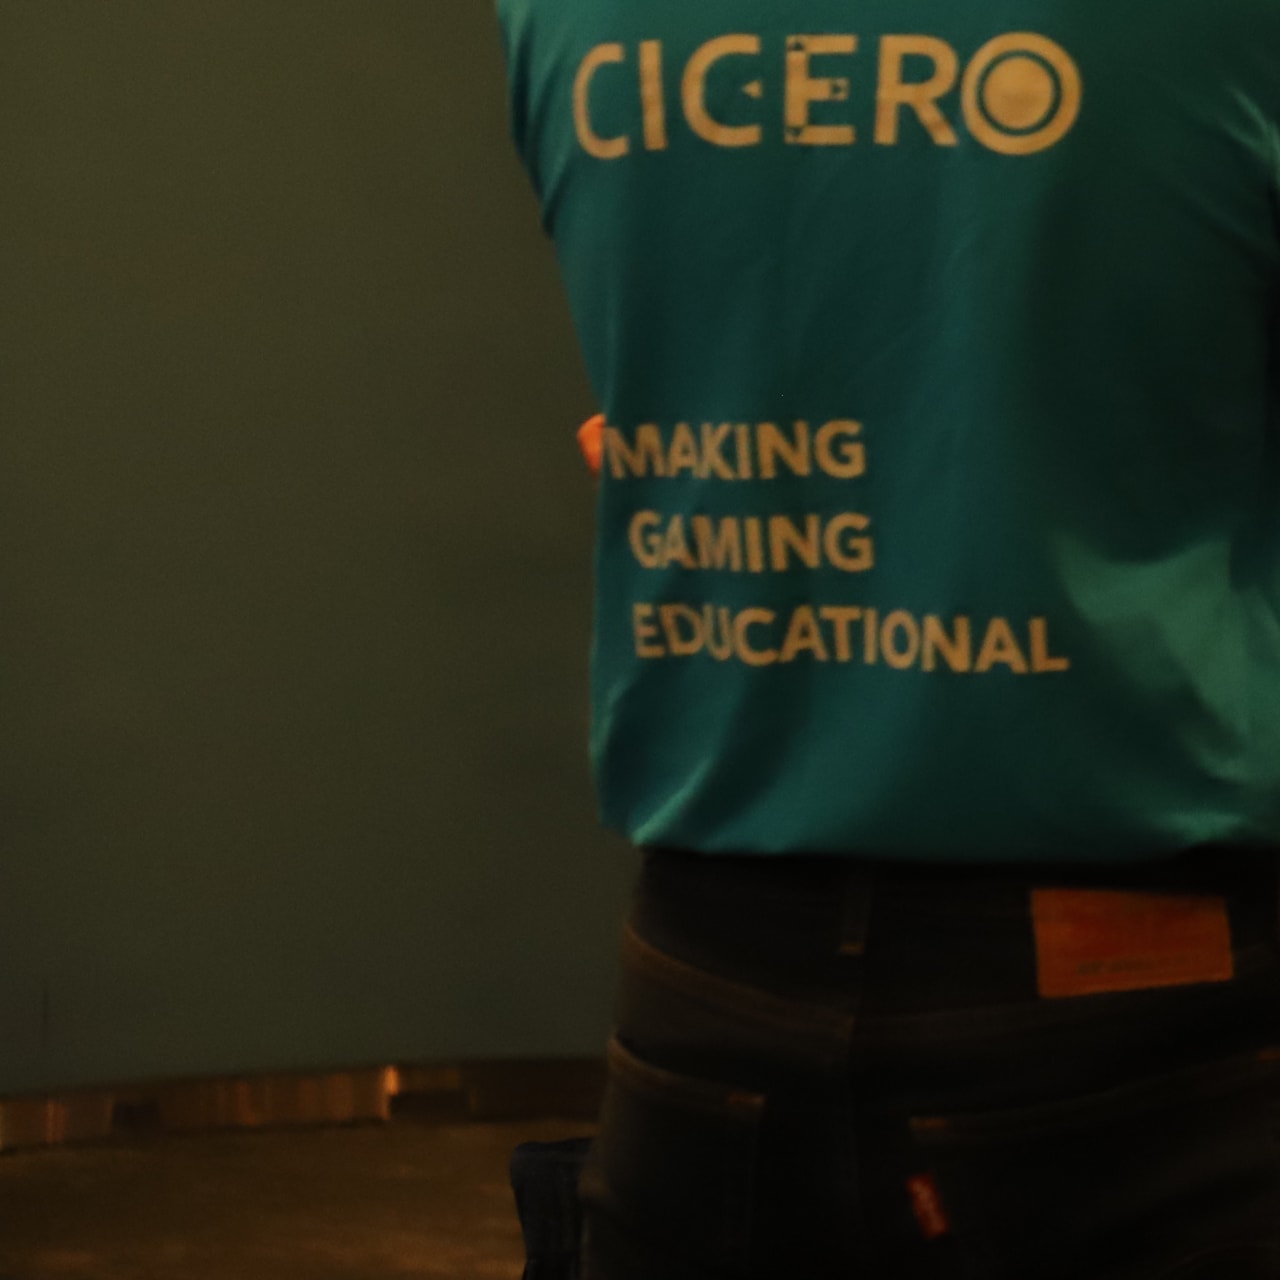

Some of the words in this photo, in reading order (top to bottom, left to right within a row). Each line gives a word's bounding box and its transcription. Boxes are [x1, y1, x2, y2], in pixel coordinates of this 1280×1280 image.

[573, 31, 1083, 160] CICERO
[604, 419, 867, 481] MAKING
[628, 509, 875, 573] GAMING
[631, 603, 1072, 674] EDUCATIONAL
